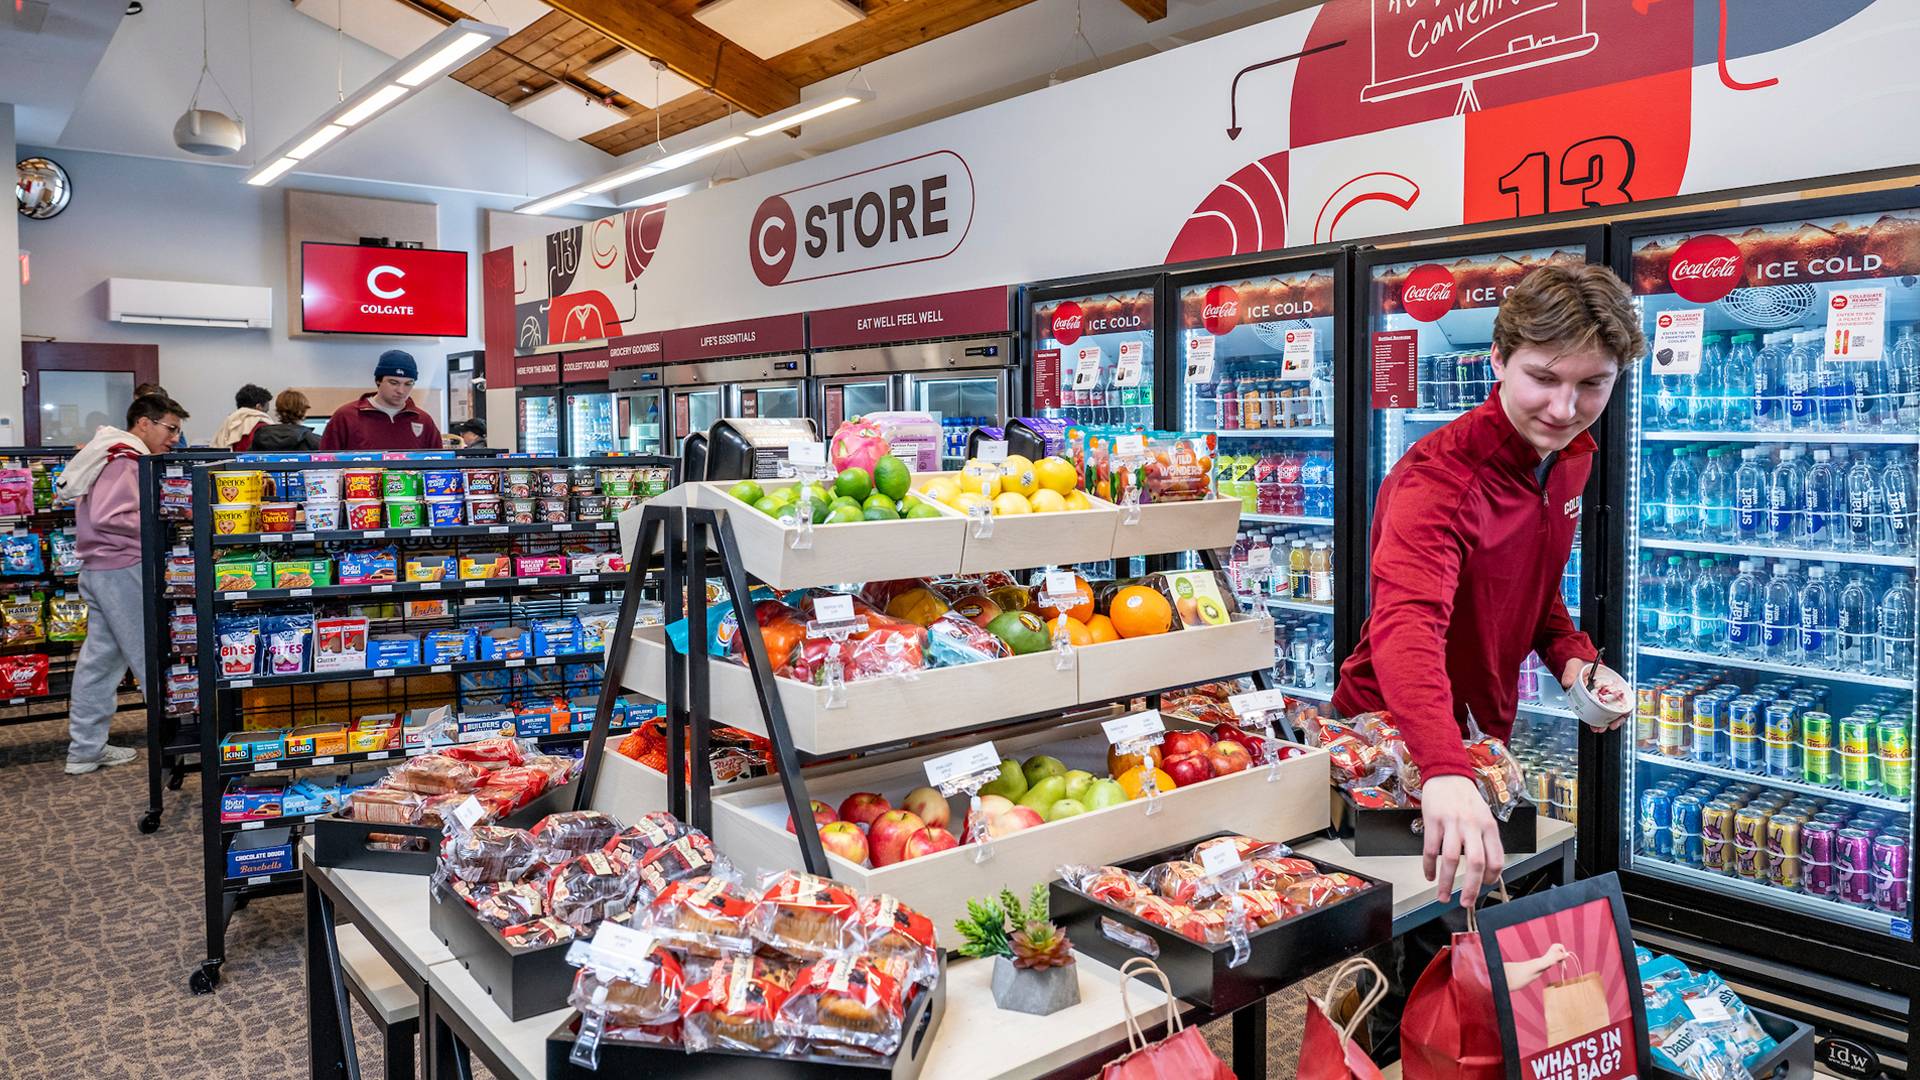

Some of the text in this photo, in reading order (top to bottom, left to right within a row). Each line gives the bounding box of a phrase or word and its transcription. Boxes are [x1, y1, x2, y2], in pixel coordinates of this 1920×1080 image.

[804, 174, 948, 258] STORE
[1671, 255, 1738, 281] Coca-Cola
[1756, 253, 1883, 280] ICE COLD
[366, 264, 406, 299] C
[1403, 281, 1452, 305] Coca-Cola
[1465, 287, 1497, 303] ICE
[360, 303, 414, 316] COLGATE
[1202, 300, 1239, 319] Coca-Cola
[1247, 301, 1313, 319] ICE COLD
[857, 309, 943, 330] EAT WELL FEEL WELL
[1052, 313, 1082, 331] Coca-Cola
[1088, 315, 1141, 331] ICE COLD
[700, 331, 756, 347] LIFE'S ESSENTIALS
[609, 343, 660, 358] GROCERY GOODNESS
[563, 359, 609, 372] COOLEST FOOD AROU
[1170, 454, 1192, 465] WILD
[1160, 465, 1203, 476] WONDERS
[367, 508, 381, 516] LUCK
[262, 514, 290, 524] Cheerios
[341, 563, 361, 571] Nutri
[221, 644, 255, 657] BITES
[269, 643, 303, 655] BITES
[466, 721, 500, 730] BUILDERS
[524, 716, 546, 724] BUILDERS
[225, 750, 247, 758] KIND
[290, 744, 311, 753] KIND
[1844, 745, 1865, 754] Chico
[225, 799, 245, 807] Nutri
[235, 850, 285, 862] CHOCOLATE DOUGH
[240, 861, 282, 873] Barebells
[1531, 1027, 1622, 1080] WHAT'S IN
[1828, 1042, 1868, 1068] idw
[1577, 1050, 1622, 1080] BAG?
